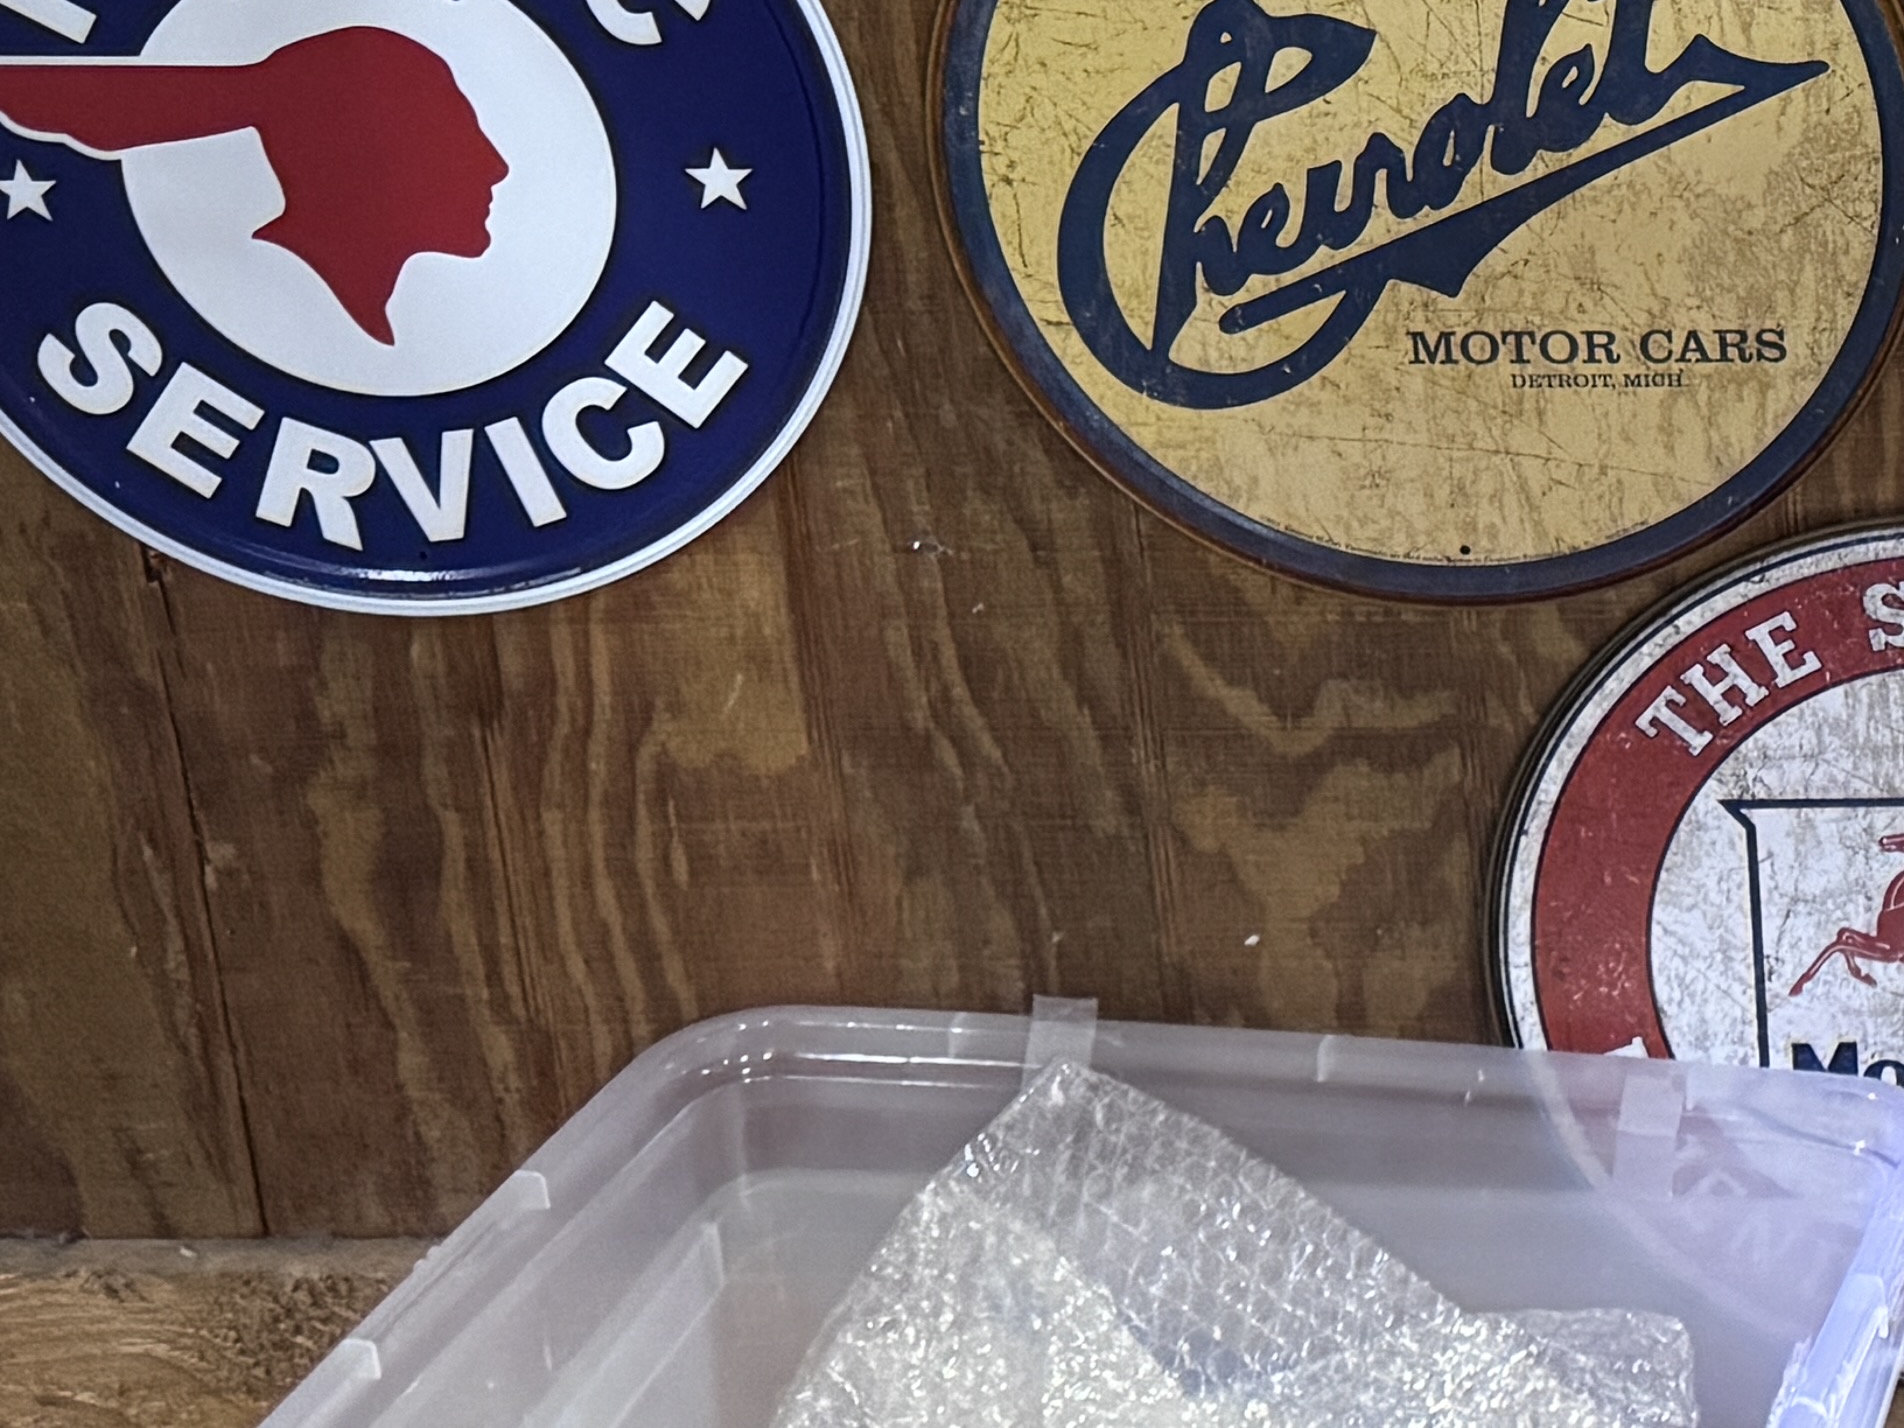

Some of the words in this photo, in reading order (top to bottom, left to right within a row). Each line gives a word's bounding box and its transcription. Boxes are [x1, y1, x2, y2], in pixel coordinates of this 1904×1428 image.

[1407, 330, 1623, 367] MOTOR
[1639, 325, 1789, 366] CARS
[1511, 372, 1616, 390] DETROIT,
[37, 299, 750, 552] SERVICE
[1635, 610, 1823, 759] THE
